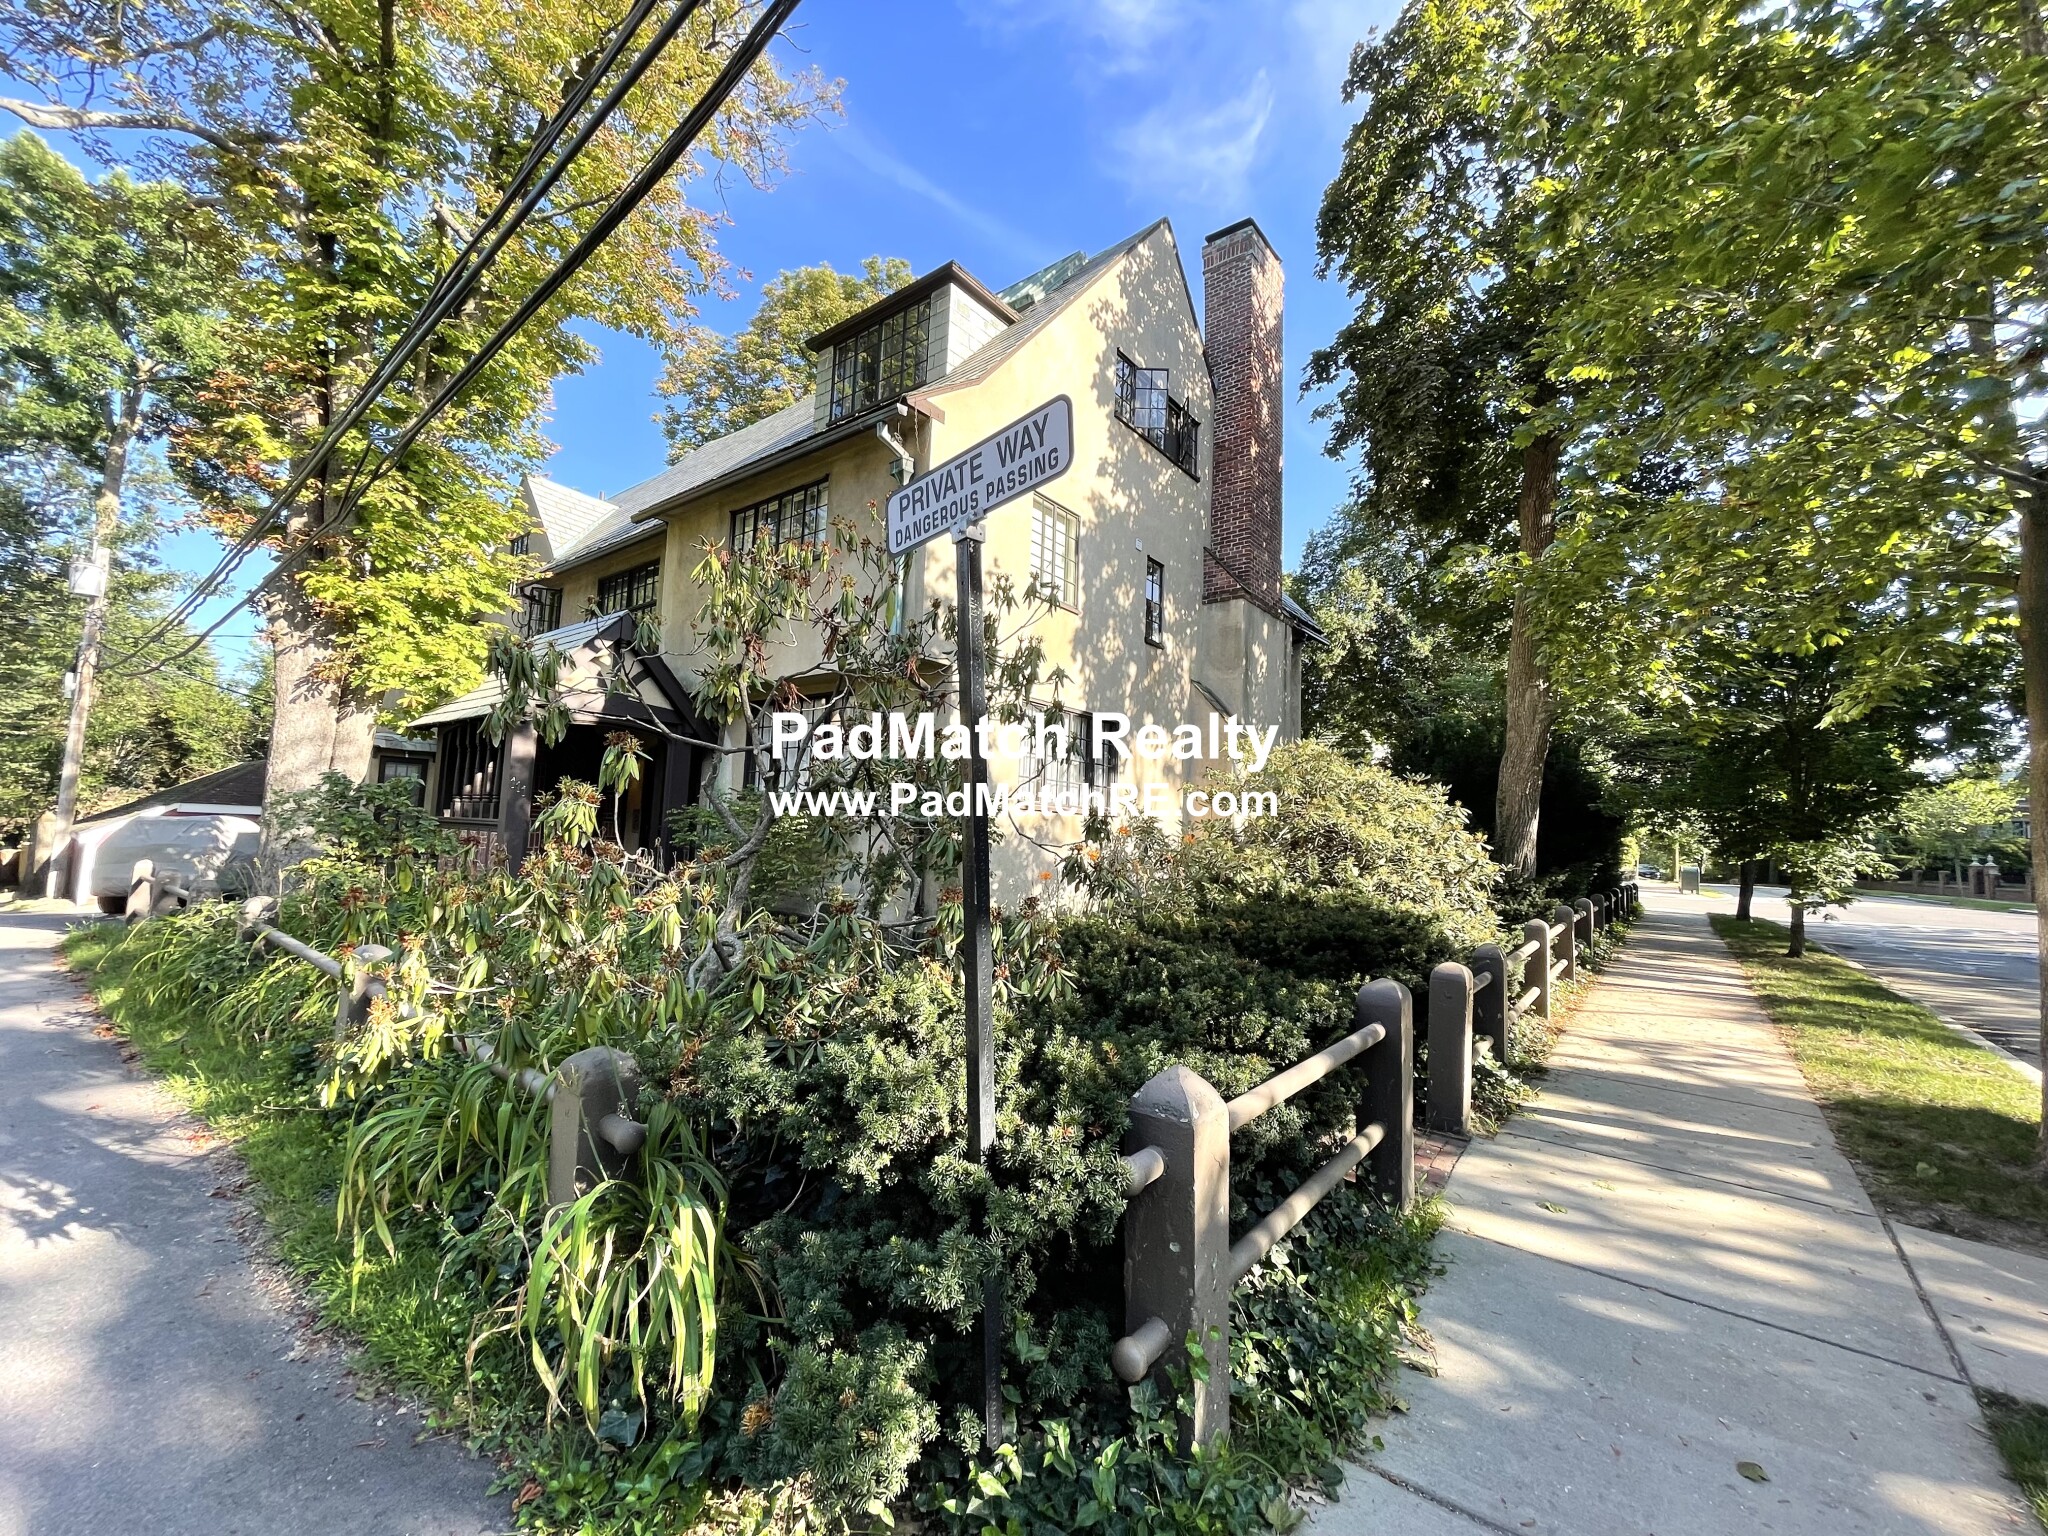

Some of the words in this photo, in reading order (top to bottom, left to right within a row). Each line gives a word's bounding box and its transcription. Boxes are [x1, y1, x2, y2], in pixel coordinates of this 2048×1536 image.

[895, 489, 979, 548] DANGEROUS
[986, 447, 1059, 503] PASSING
[899, 451, 984, 523] PRIVATE
[996, 412, 1050, 469] WAY
